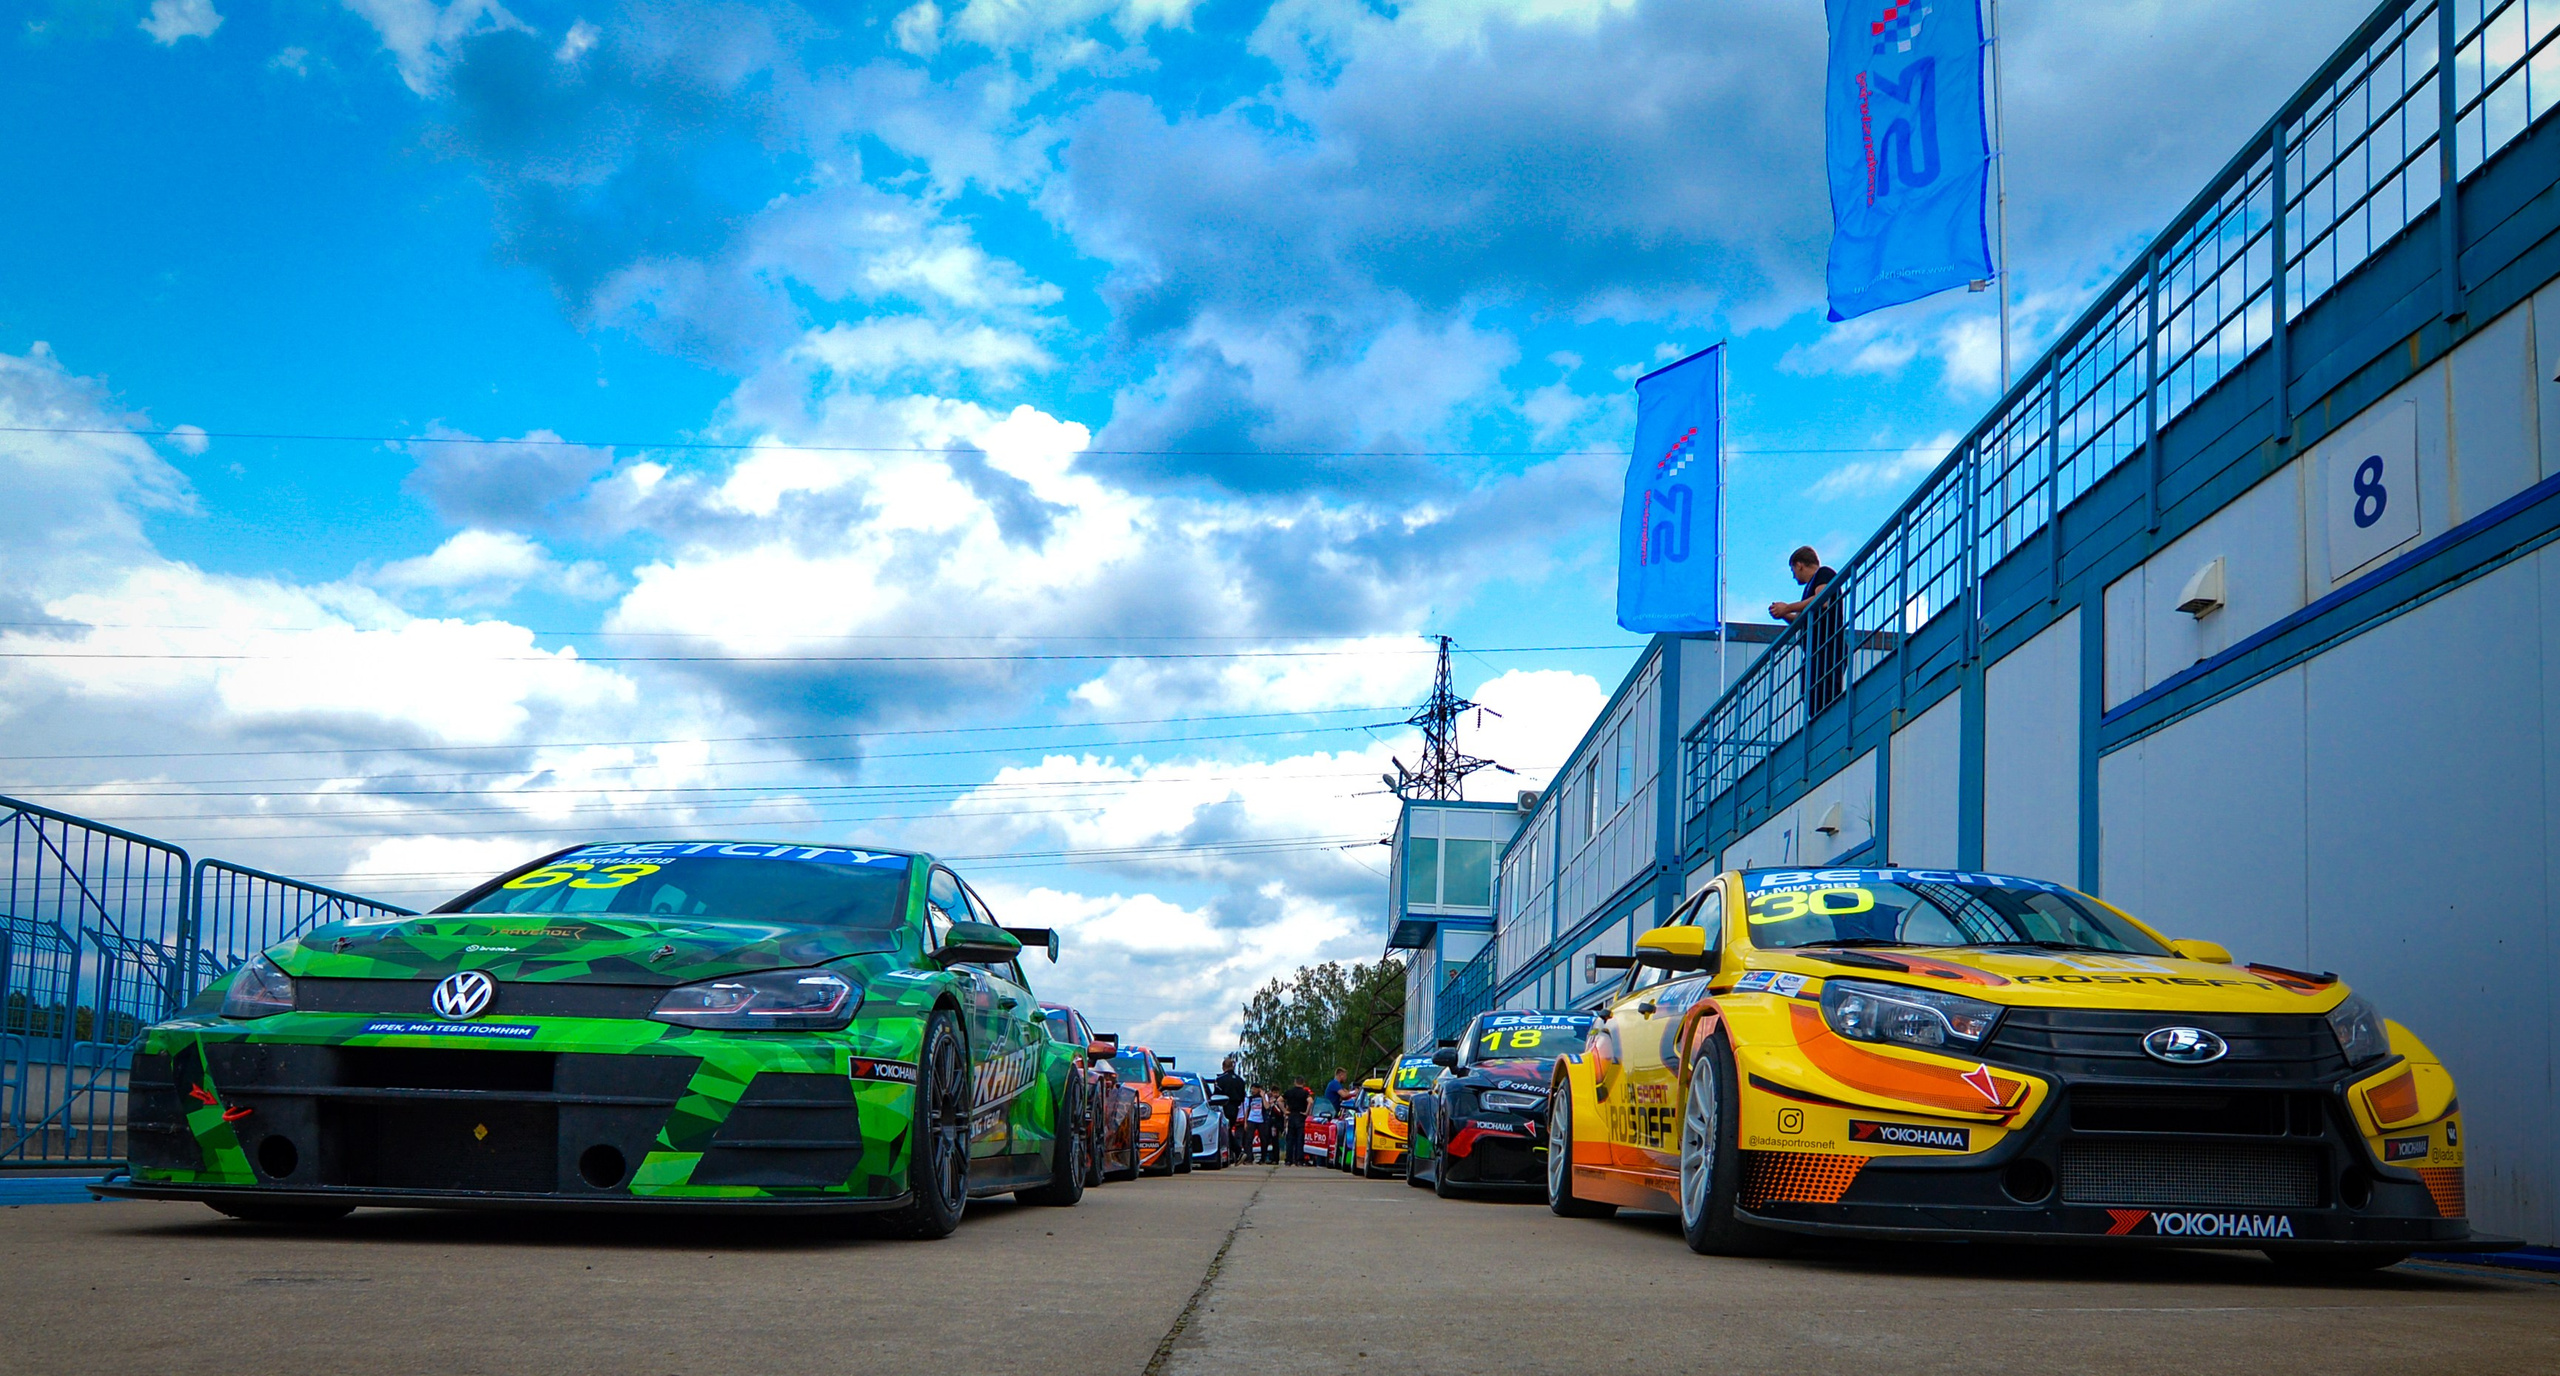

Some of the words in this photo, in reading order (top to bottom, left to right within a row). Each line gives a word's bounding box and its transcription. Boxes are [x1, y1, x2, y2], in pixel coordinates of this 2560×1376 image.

[2353, 454, 2388, 529] 8
[502, 863, 661, 889] 63
[1747, 882, 1860, 899] М.МИТЯЕВ
[1748, 888, 1875, 925] 30
[2014, 974, 2275, 991] ROSNEFT
[369, 1024, 405, 1032] ИРЕК,
[409, 1024, 433, 1032] МЫ
[470, 1026, 532, 1035] ПОМНИМ
[1480, 1029, 1542, 1051] 18
[873, 1062, 918, 1081] YOKOHAM
[1397, 1067, 1418, 1081] 11
[1637, 1084, 1668, 1104] SPORT
[1476, 1121, 1513, 1132] YOKOHAMA
[1749, 1136, 1836, 1150] @ladasportrosneft
[1879, 1126, 1964, 1147] YOKOHAMA
[2151, 1212, 2294, 1238] YOKOHAMA
